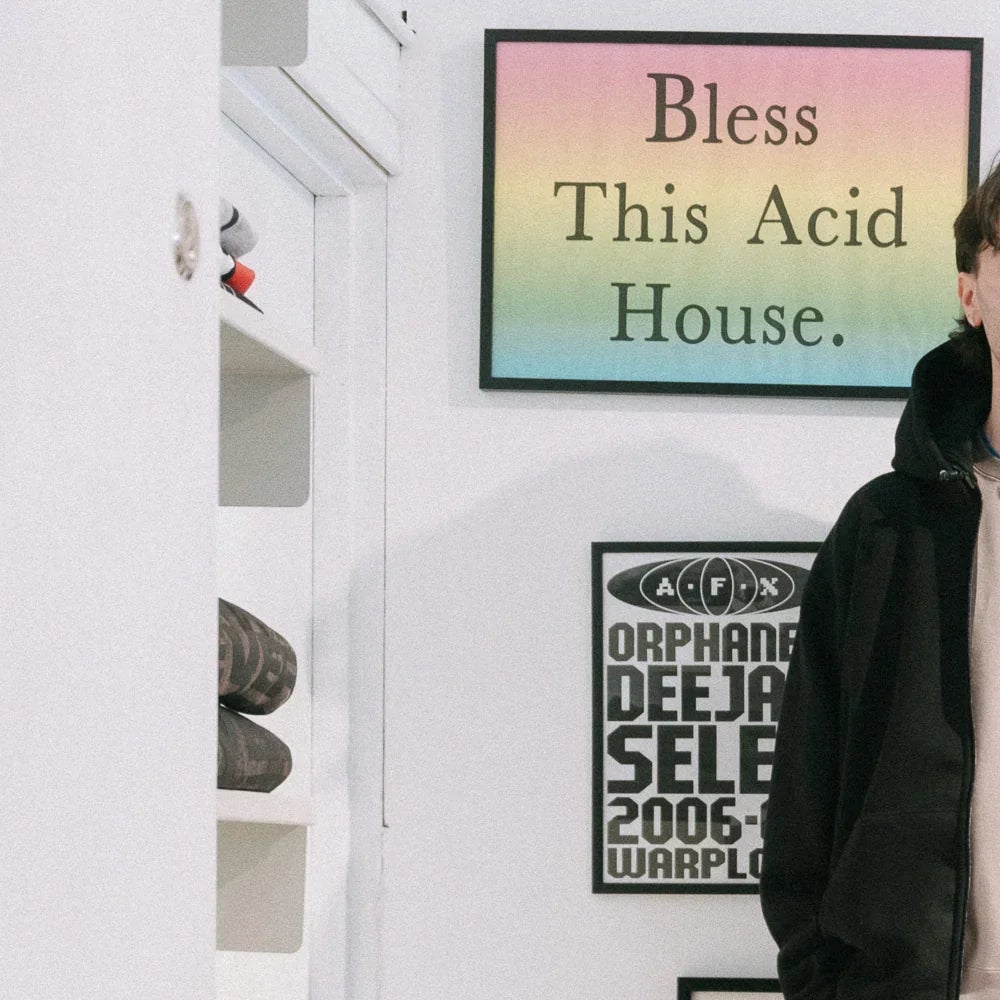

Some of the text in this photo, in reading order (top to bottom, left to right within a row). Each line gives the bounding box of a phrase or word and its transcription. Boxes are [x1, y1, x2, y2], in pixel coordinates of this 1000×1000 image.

[646, 72, 819, 146] Bless
[553, 181, 908, 249] This Acid
[609, 282, 845, 348] House.
[607, 665, 786, 722] DEEJA
[607, 725, 777, 794] SELE
[607, 797, 769, 845] 2006-
